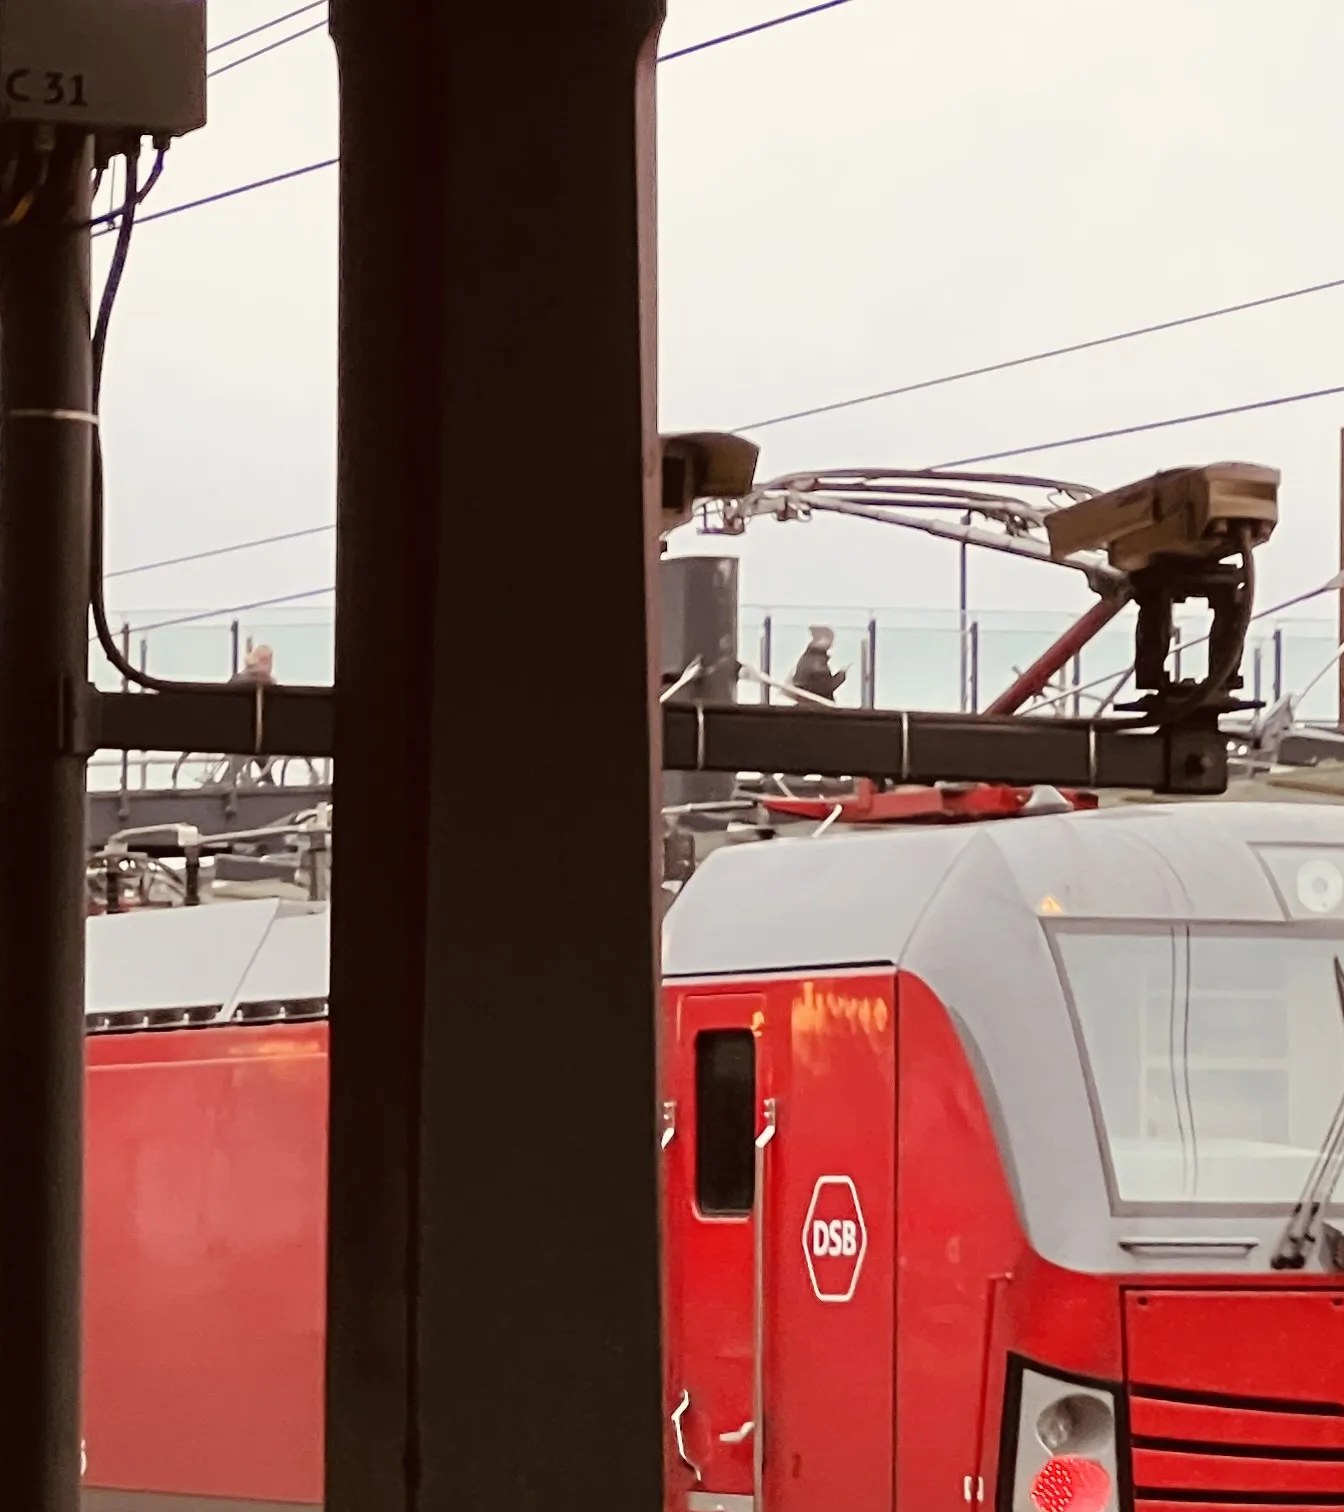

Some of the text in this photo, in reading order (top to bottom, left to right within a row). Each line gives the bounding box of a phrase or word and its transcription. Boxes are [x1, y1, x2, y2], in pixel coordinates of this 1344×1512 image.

[6, 68, 89, 107] C 31
[813, 1219, 857, 1257] DSB
